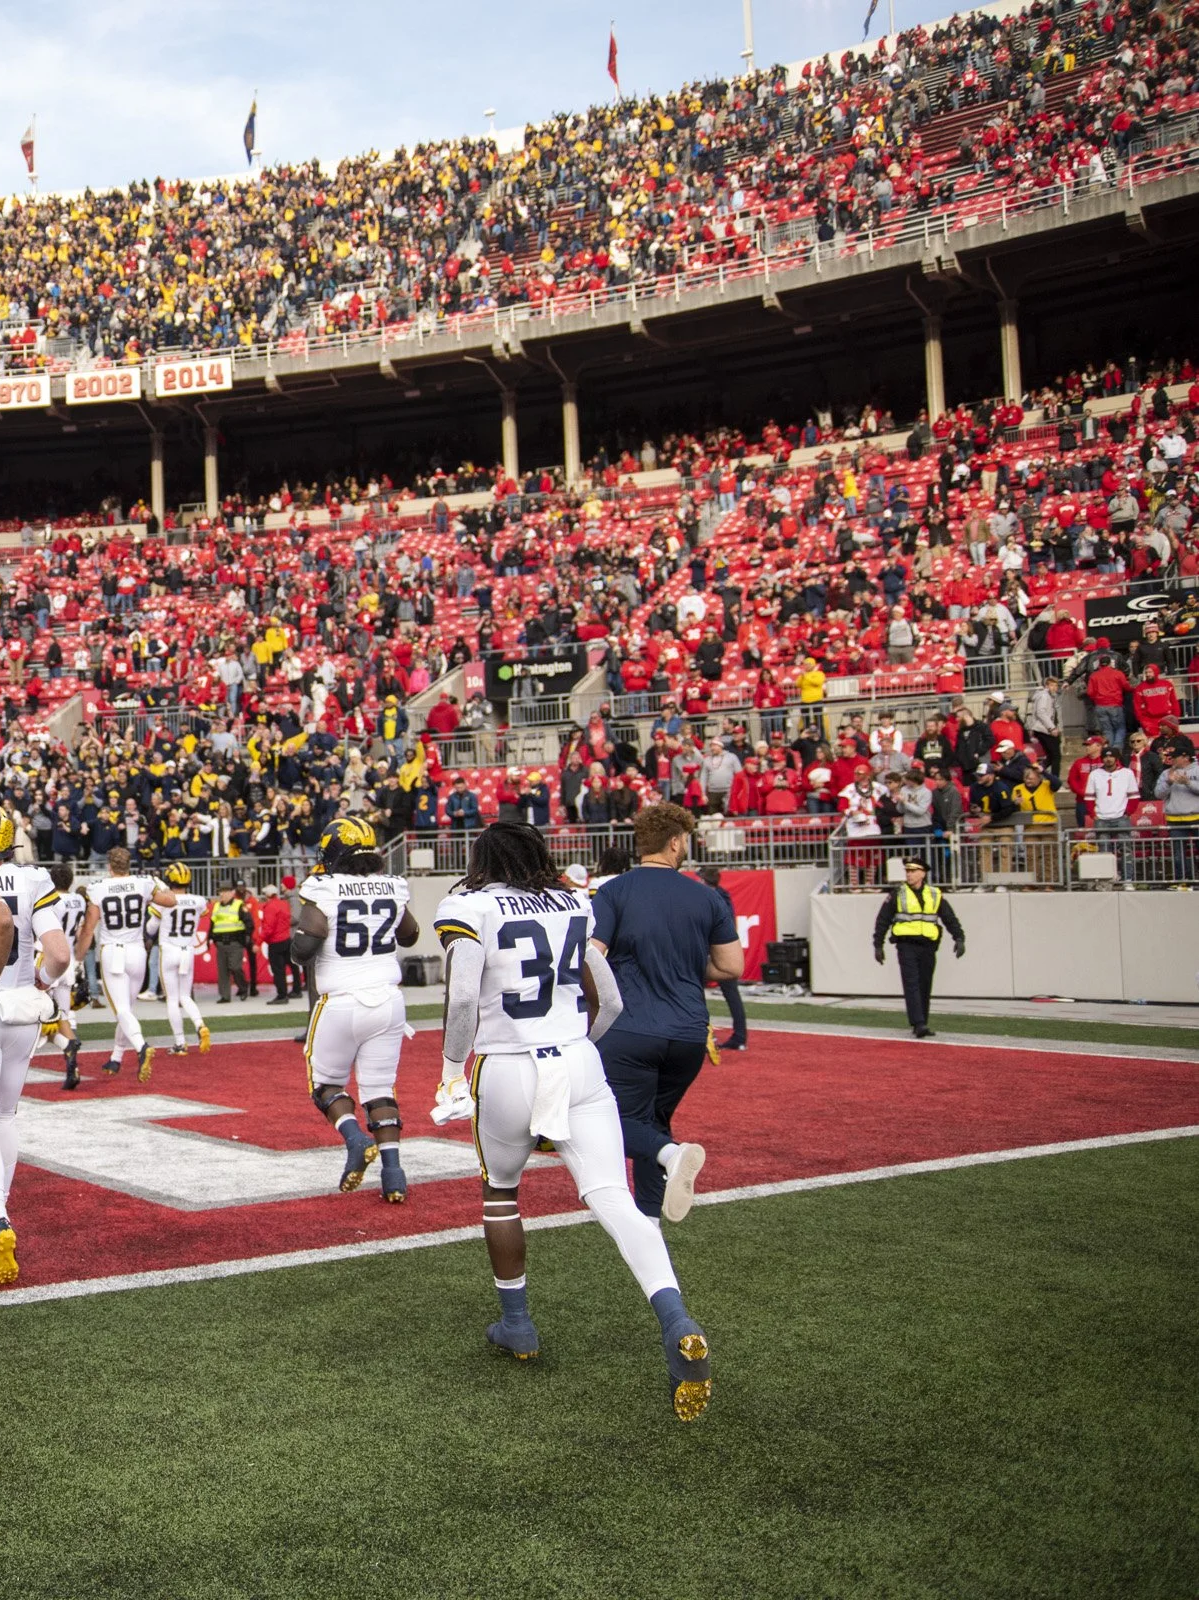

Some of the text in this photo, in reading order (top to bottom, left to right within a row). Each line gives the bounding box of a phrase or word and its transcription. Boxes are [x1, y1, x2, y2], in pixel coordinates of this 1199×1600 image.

[73, 374, 133, 398] 2002
[162, 362, 224, 390] 2014
[513, 661, 573, 677] Hntington
[1106, 778, 1113, 796] 1
[108, 883, 136, 894] HIBNER
[338, 881, 396, 897] ANDERSON
[102, 894, 144, 931] 88
[495, 893, 582, 916] FRANKLIN
[168, 908, 196, 938] 16
[335, 898, 398, 958] 62
[497, 915, 589, 1020] 34
[536, 1045, 562, 1060] M
